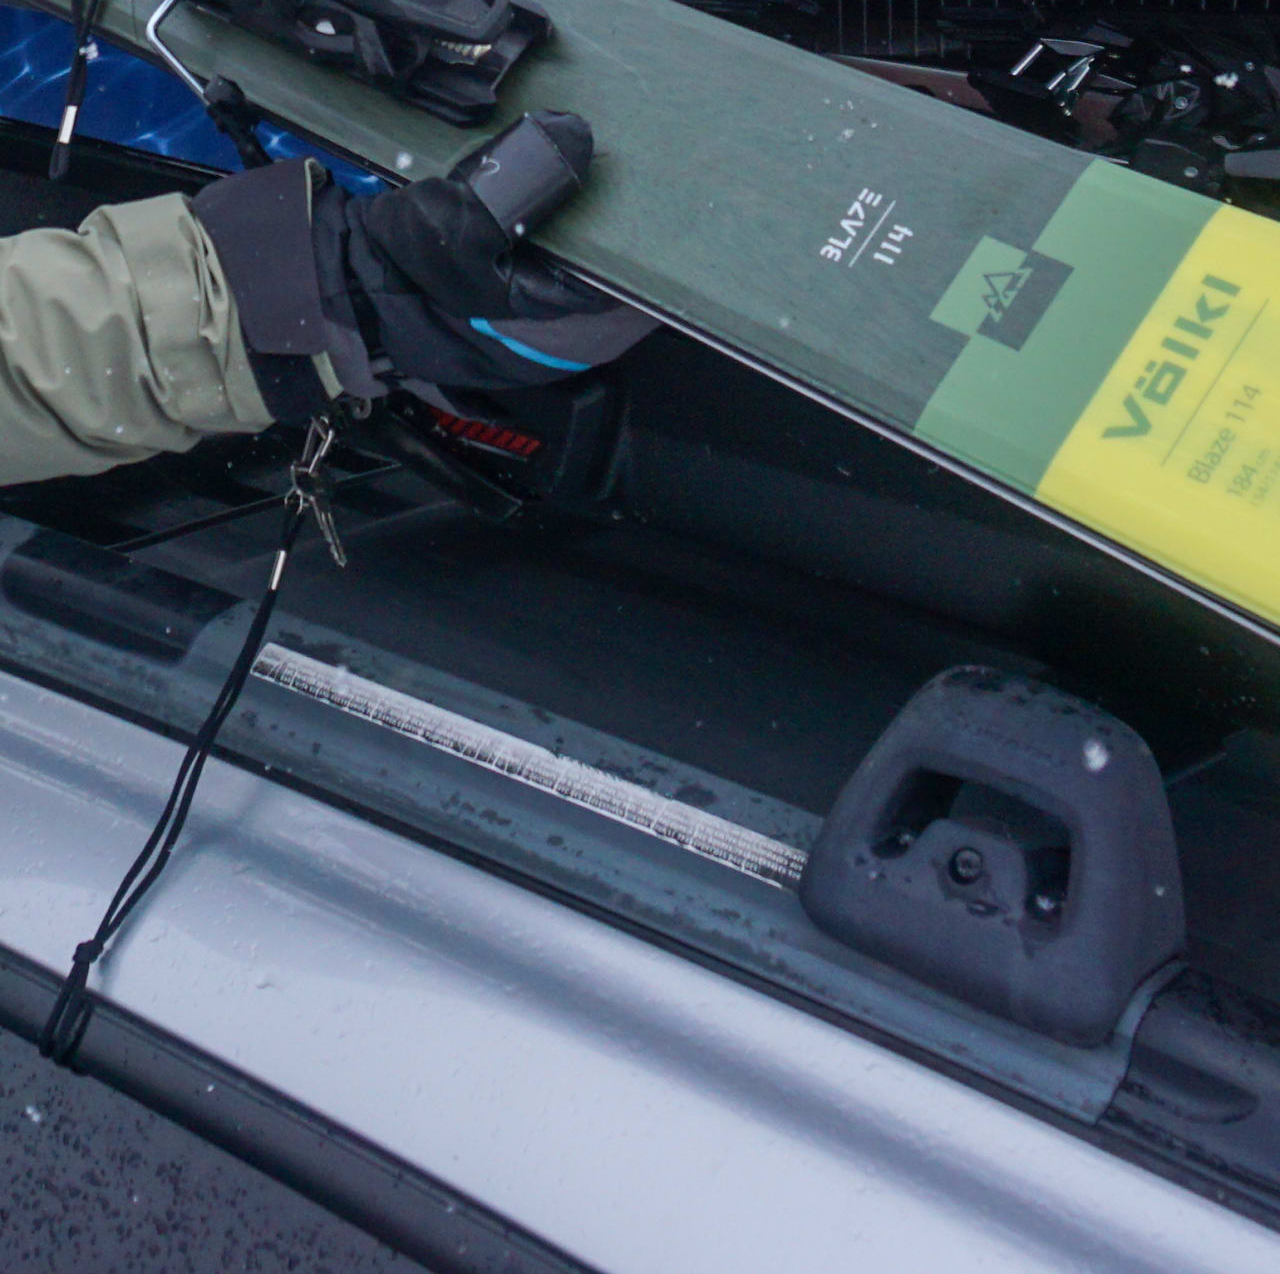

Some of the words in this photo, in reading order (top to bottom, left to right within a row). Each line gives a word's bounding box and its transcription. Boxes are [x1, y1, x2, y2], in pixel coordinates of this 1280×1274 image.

[873, 224, 915, 266] 114
[1100, 274, 1242, 440] Völkl
[1187, 427, 1237, 484] Blaze
[1226, 384, 1262, 422] 114
